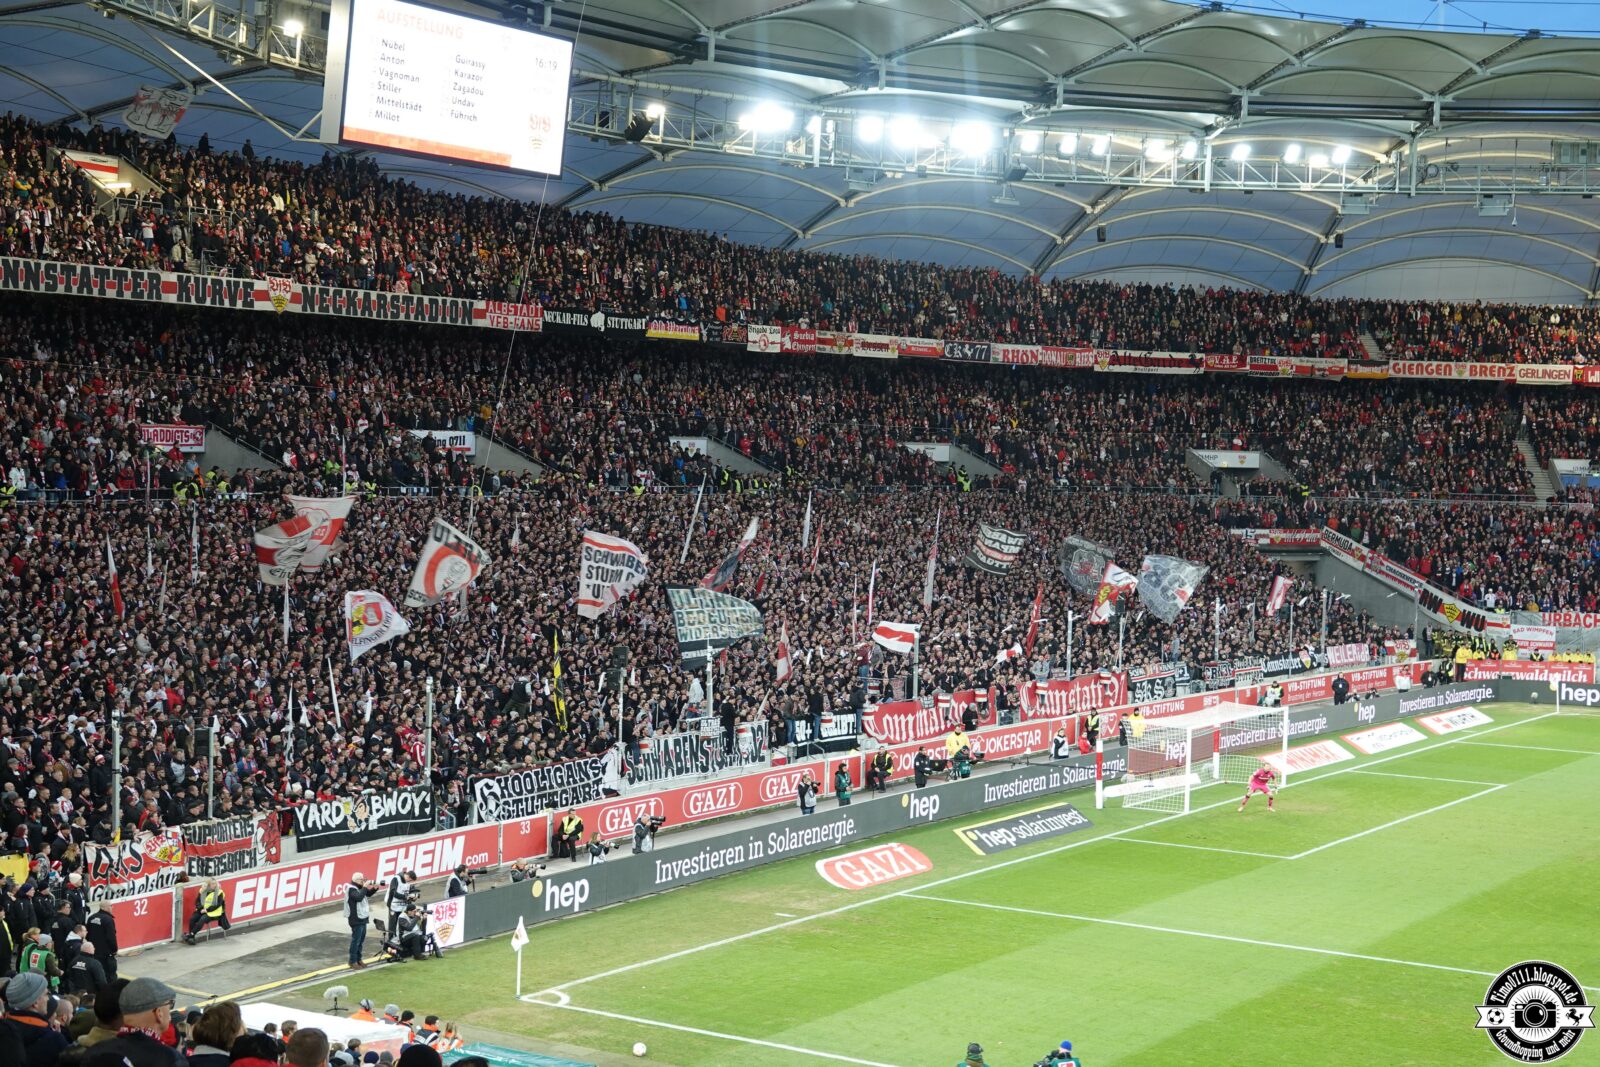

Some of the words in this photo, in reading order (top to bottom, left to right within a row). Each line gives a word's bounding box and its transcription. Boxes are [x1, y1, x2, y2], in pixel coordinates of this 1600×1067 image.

[376, 8, 463, 39] AUFSTELLUNG
[380, 53, 405, 66] Anton
[455, 54, 486, 71] Guirassy
[379, 67, 420, 84] Vagnoman
[454, 69, 483, 82] Karazor
[377, 81, 402, 94] Stiller
[453, 82, 485, 97] Zagadou
[451, 97, 476, 108] Undav
[374, 109, 400, 122] Millot
[176, 273, 254, 308] KURVE
[301, 286, 473, 325] NECKARSTADION
[487, 303, 543, 318] ALBSTADT
[542, 310, 589, 327] NECKAR-FILS
[606, 316, 648, 331] STUTTGART
[974, 344, 988, 360] 77
[1002, 347, 1039, 364] RHÖN
[1042, 349, 1067, 367] DONAU
[1074, 351, 1094, 368] RIES
[1392, 362, 1453, 377] GIENGEN
[1469, 364, 1516, 378] BRENZ
[1518, 367, 1571, 380] GERLINGEN
[448, 435, 466, 447] 0711
[1287, 678, 1326, 694] VfB-STIFTUNG
[1561, 684, 1600, 706] hep
[1358, 703, 1376, 723] hep
[1399, 693, 1436, 714] Investieren
[1437, 690, 1444, 705] in
[1445, 685, 1495, 705] Solarenergie.
[983, 728, 1042, 755] JOKERSTAR
[1165, 738, 1187, 762] hep
[1218, 723, 1266, 750] nvestieren
[496, 757, 602, 800] HOOLIGANS
[909, 793, 940, 821] hep
[983, 773, 1048, 803] Investieren
[1049, 767, 1060, 786] in
[295, 801, 346, 832] YARD
[184, 816, 256, 846] SUPPORTERS
[520, 820, 531, 835] 33
[980, 827, 1017, 850] hep
[1014, 808, 1090, 842] solarinvest
[187, 847, 259, 878] EBERSBACH
[544, 877, 591, 913] hep
[655, 848, 745, 885] Investieren
[749, 836, 764, 861] in
[767, 814, 858, 856] Solarenergie.
[834, 844, 929, 889] GAZI
[133, 898, 149, 917] 32
